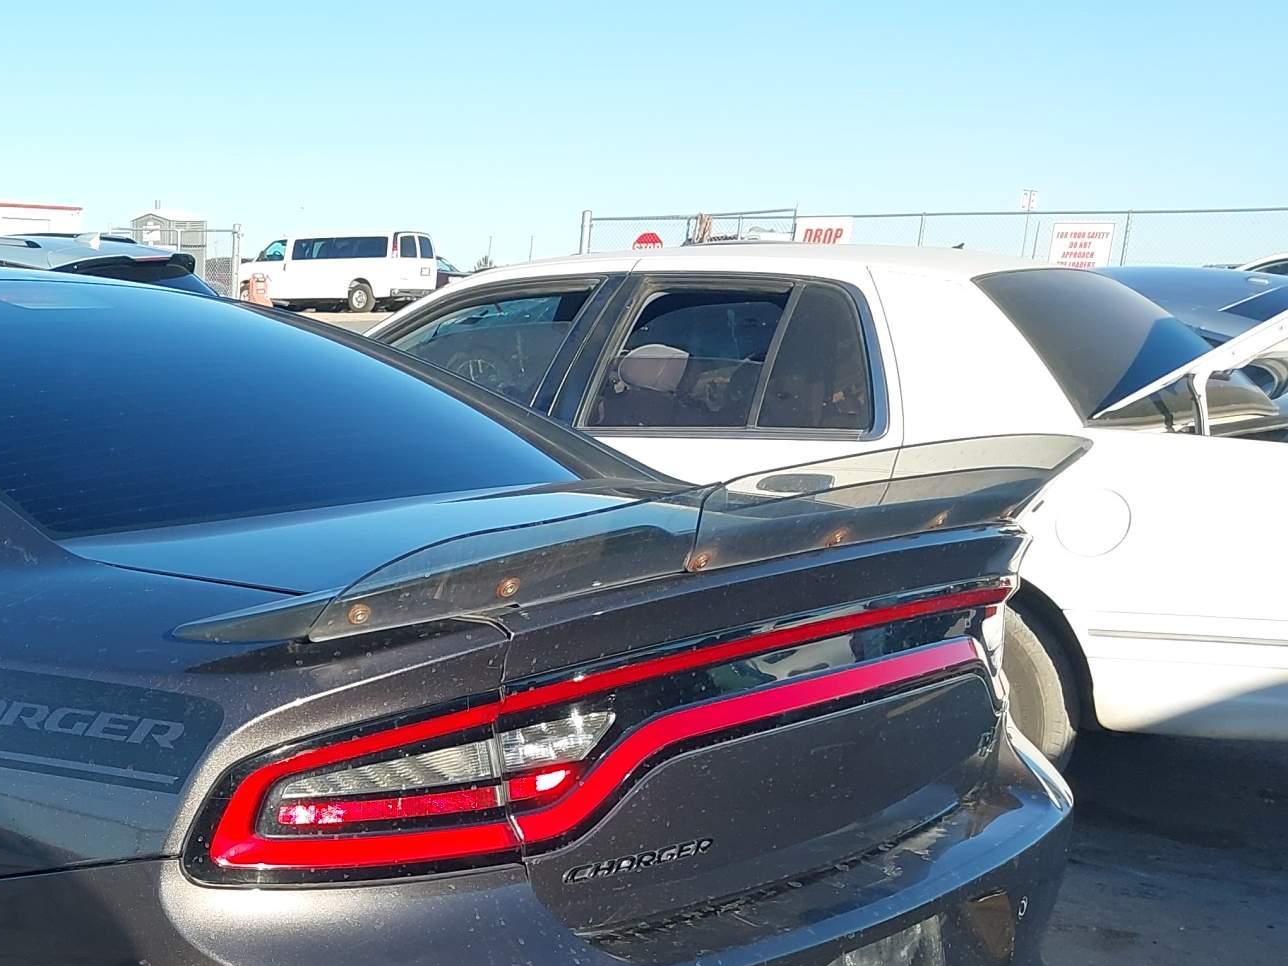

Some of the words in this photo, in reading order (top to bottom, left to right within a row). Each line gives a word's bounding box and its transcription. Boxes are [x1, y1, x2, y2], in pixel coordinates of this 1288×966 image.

[803, 228, 844, 244] DROP
[1087, 231, 1111, 239] SAFETY
[1061, 251, 1095, 259] APPROACH
[562, 838, 714, 885] CHARGER
